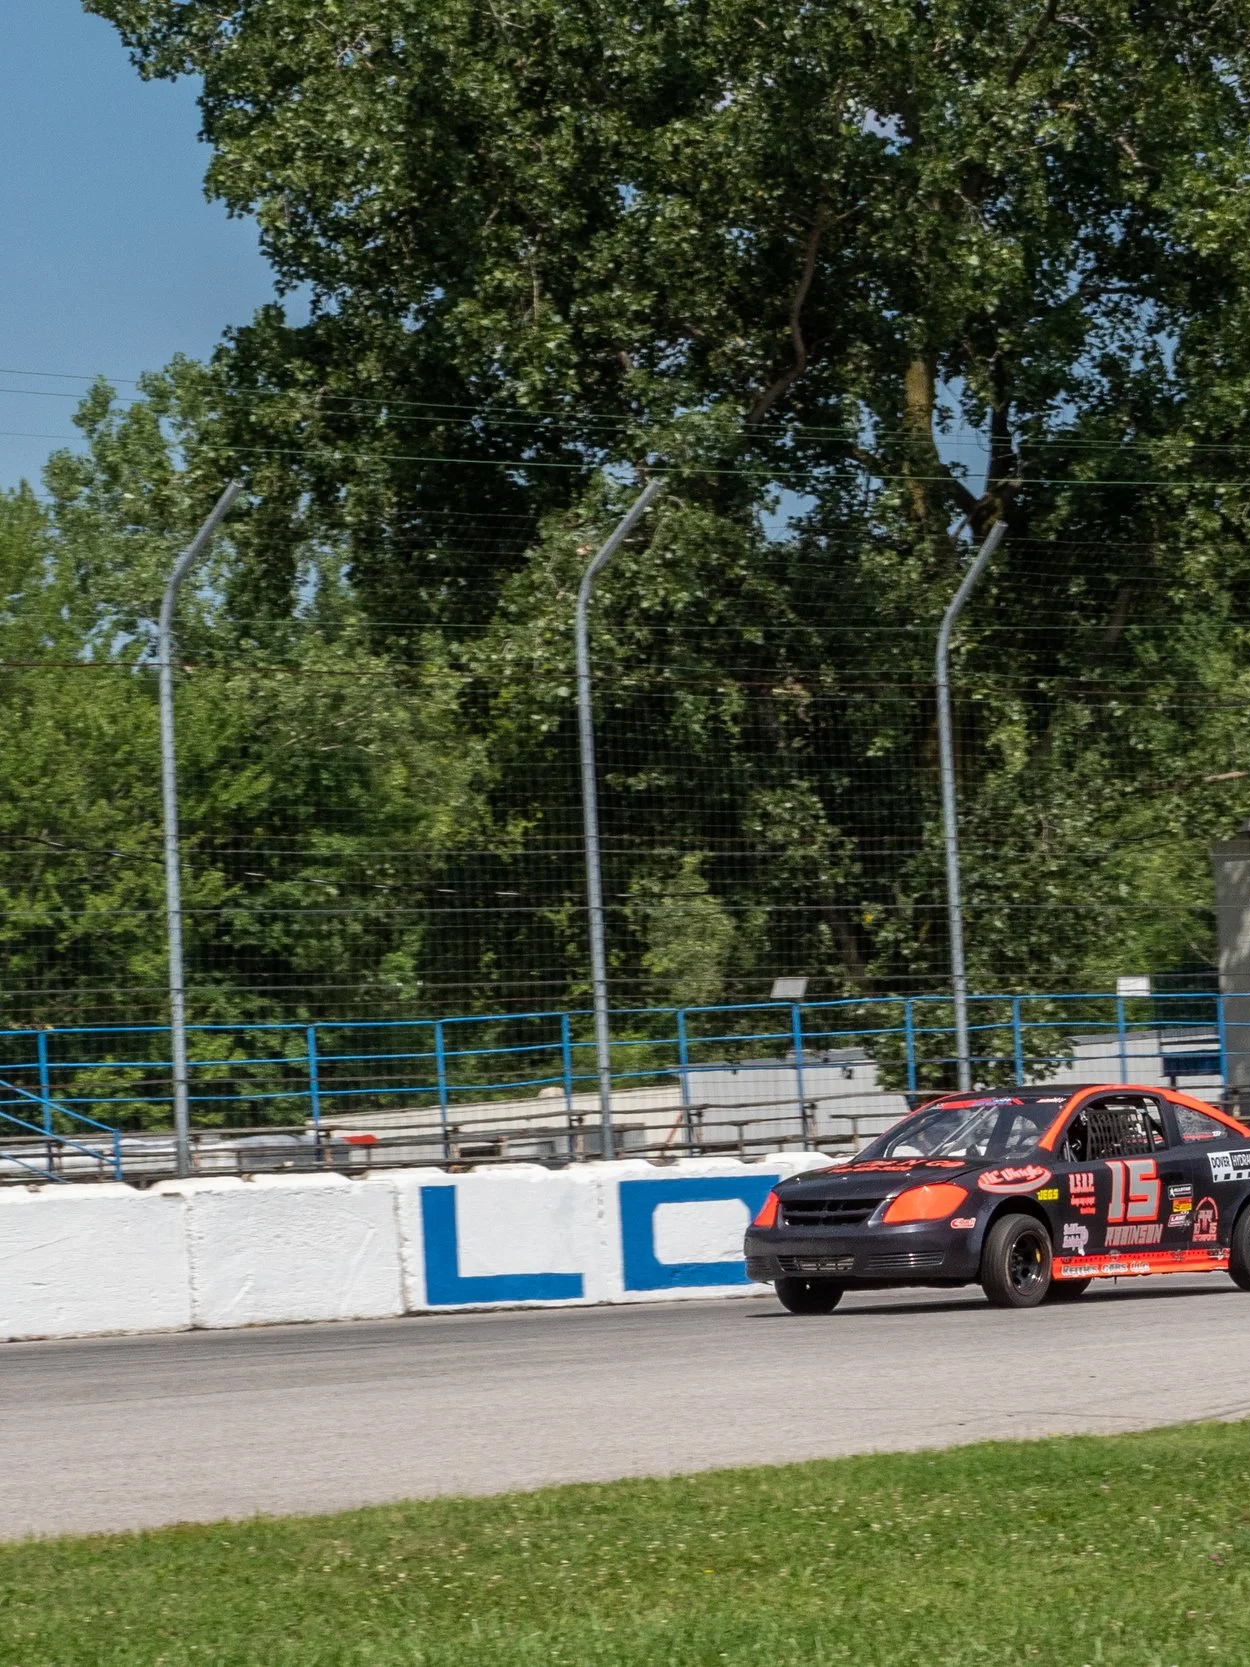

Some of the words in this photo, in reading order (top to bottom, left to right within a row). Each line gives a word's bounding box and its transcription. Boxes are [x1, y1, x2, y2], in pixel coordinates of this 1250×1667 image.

[1211, 1156, 1231, 1168] DOVER
[1037, 1189, 1059, 1201] JEGS
[1105, 1158, 1162, 1223] 15
[1105, 1224, 1163, 1247] ROBINSON
